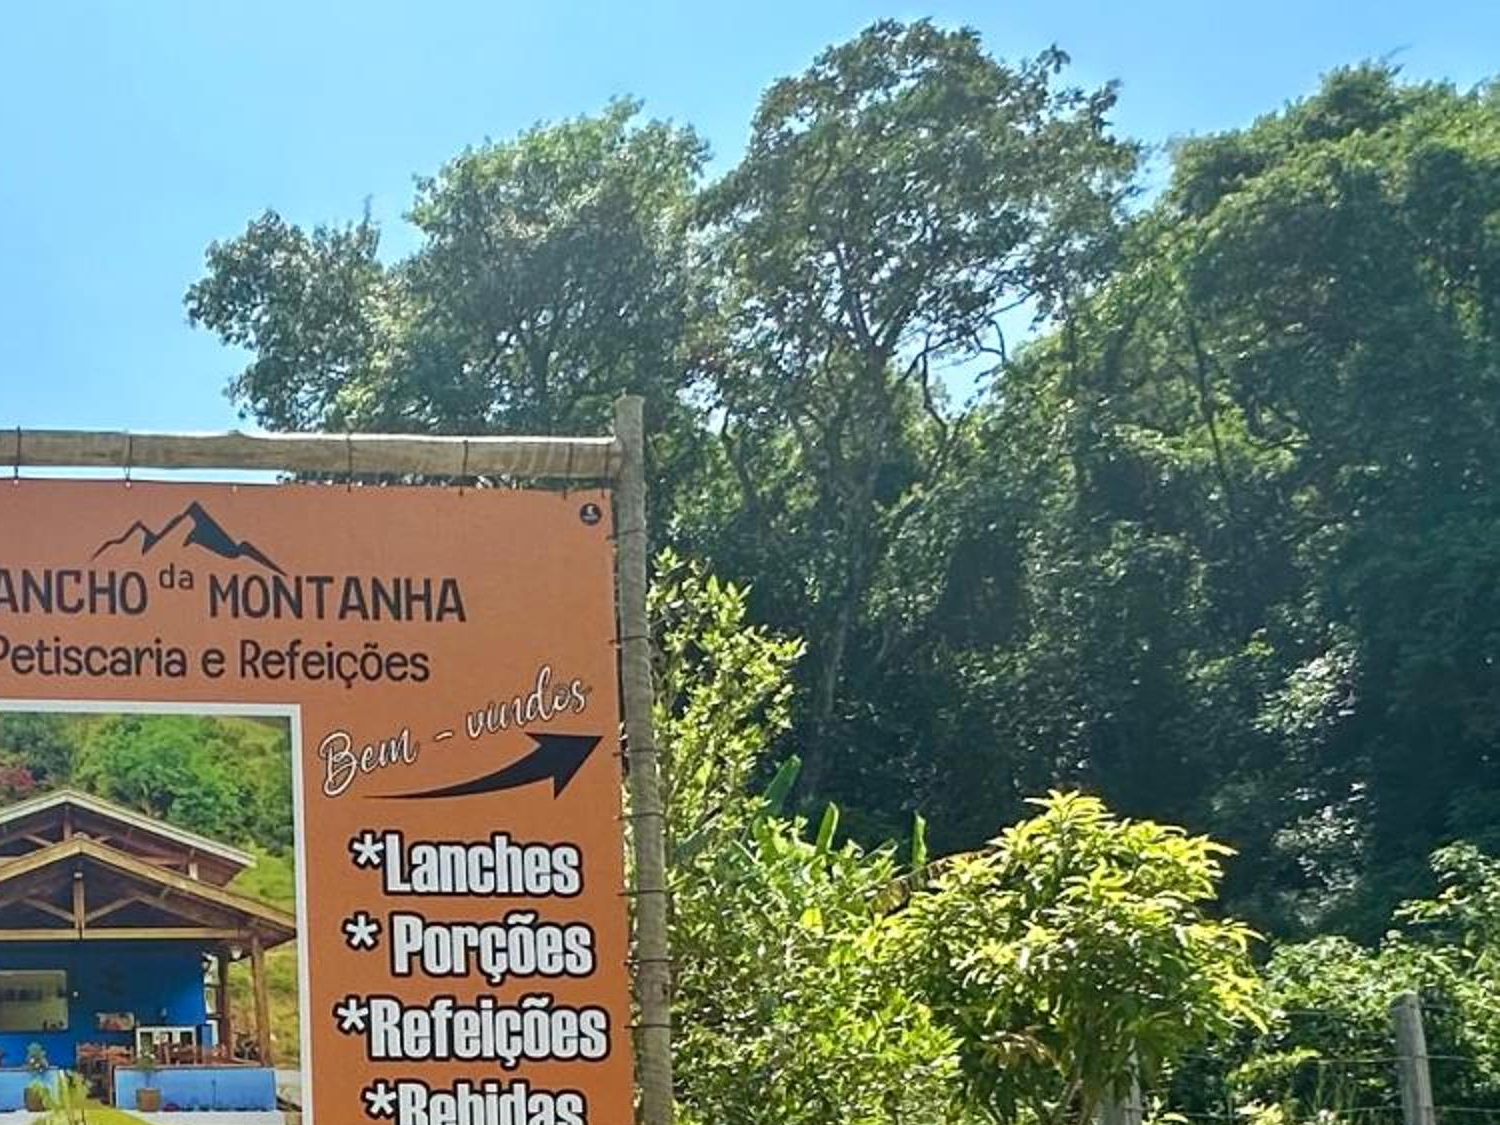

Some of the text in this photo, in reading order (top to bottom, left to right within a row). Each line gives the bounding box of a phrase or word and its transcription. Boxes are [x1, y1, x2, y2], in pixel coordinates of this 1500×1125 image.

[159, 563, 195, 591] da
[209, 573, 468, 623] MONTANHA
[202, 648, 226, 679] e
[240, 639, 431, 689] Refeições
[319, 729, 420, 797] Bem
[390, 909, 596, 983] Porções
